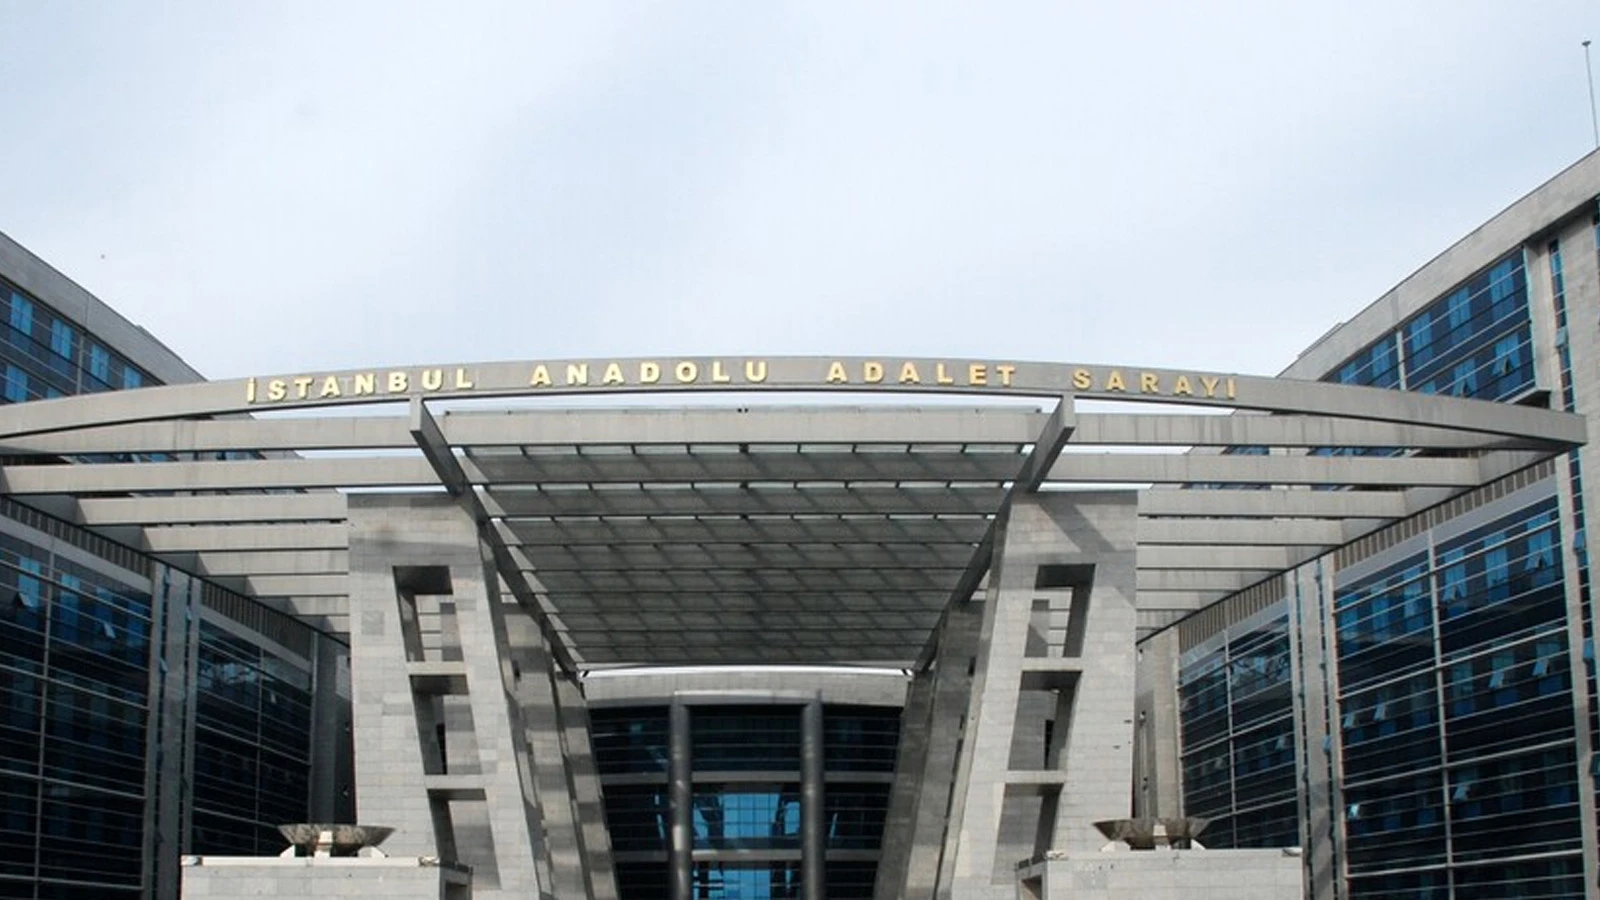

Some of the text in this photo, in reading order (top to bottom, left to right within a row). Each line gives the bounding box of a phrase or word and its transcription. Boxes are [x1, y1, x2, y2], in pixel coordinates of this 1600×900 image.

[246, 361, 1237, 402] İSTANBUL ANADOLU ADALET SARAYI
